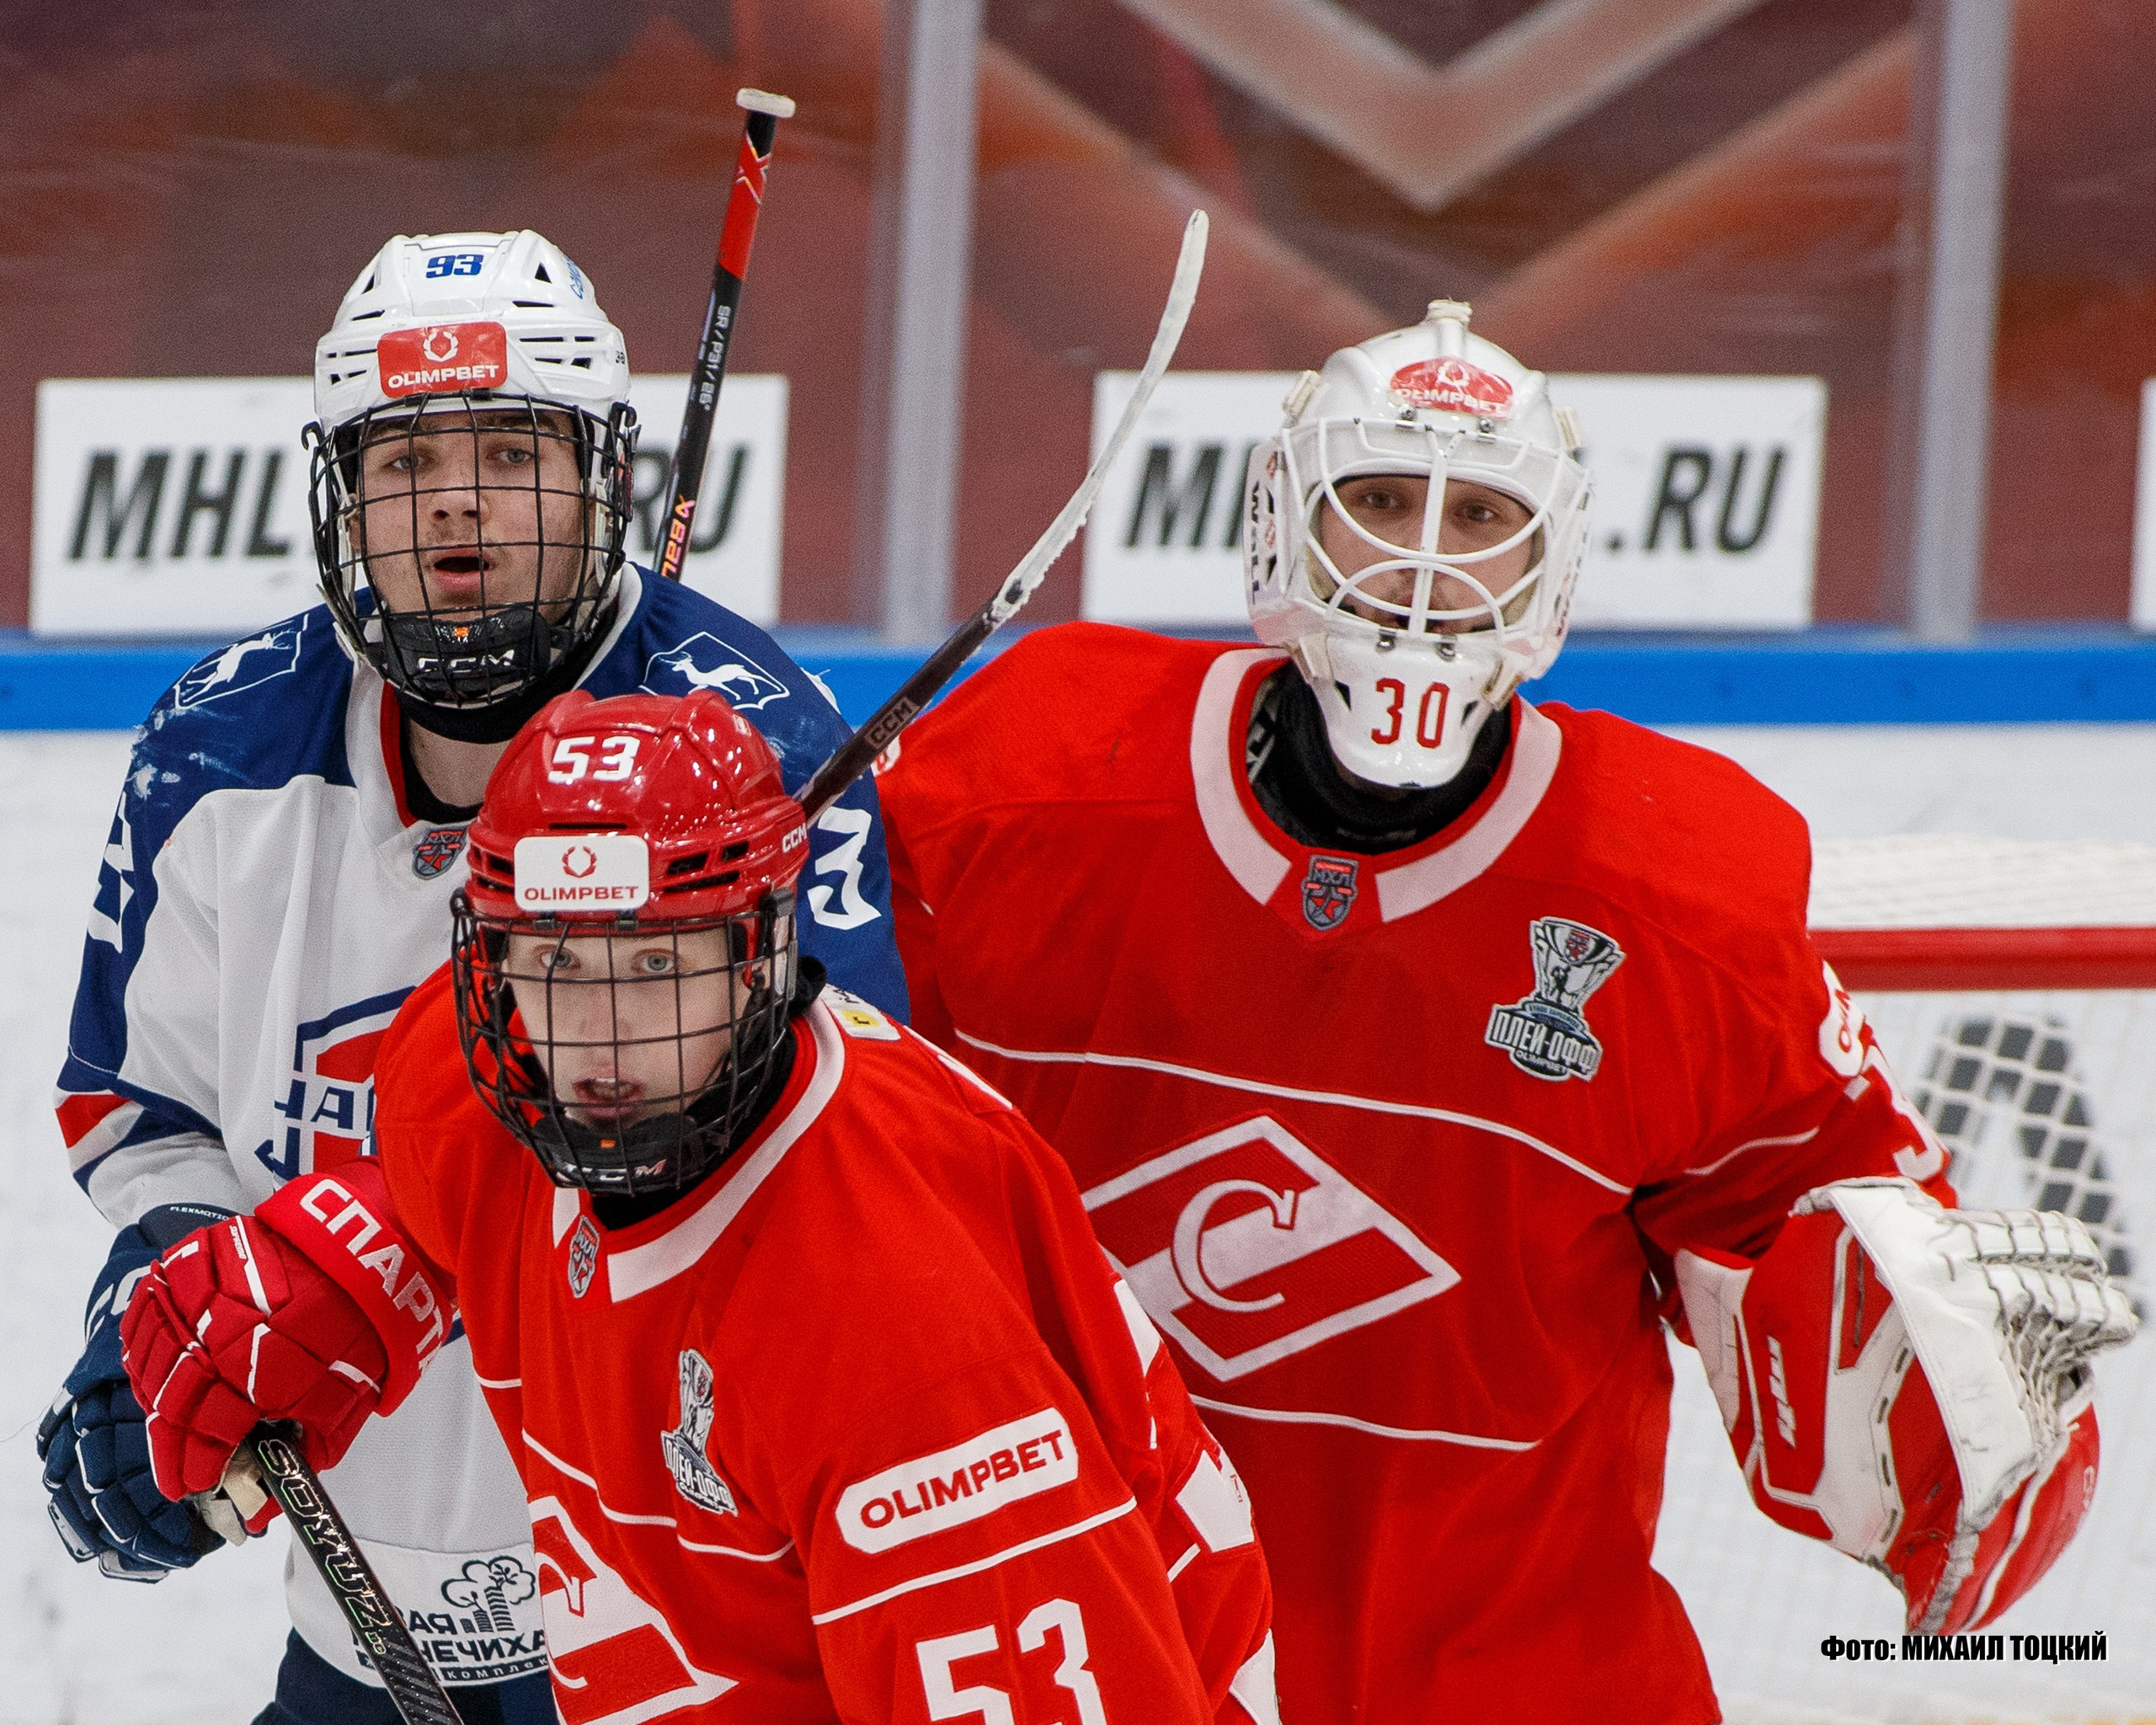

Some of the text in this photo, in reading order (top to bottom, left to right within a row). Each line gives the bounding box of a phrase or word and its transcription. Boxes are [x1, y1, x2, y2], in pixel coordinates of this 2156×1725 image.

[426, 254, 484, 278] 93
[388, 365, 499, 389] OLIMPBET
[70, 448, 291, 561] MHL
[870, 701, 914, 745] CCM
[1371, 678, 1449, 749] 30
[548, 735, 641, 783] 53
[782, 823, 807, 854] CCM
[524, 884, 639, 901] OLIMPBET
[861, 1429, 1065, 1529] OLIMPBET
[258, 1439, 392, 1628] SOYUZ
[915, 1598, 1108, 1725] 53
